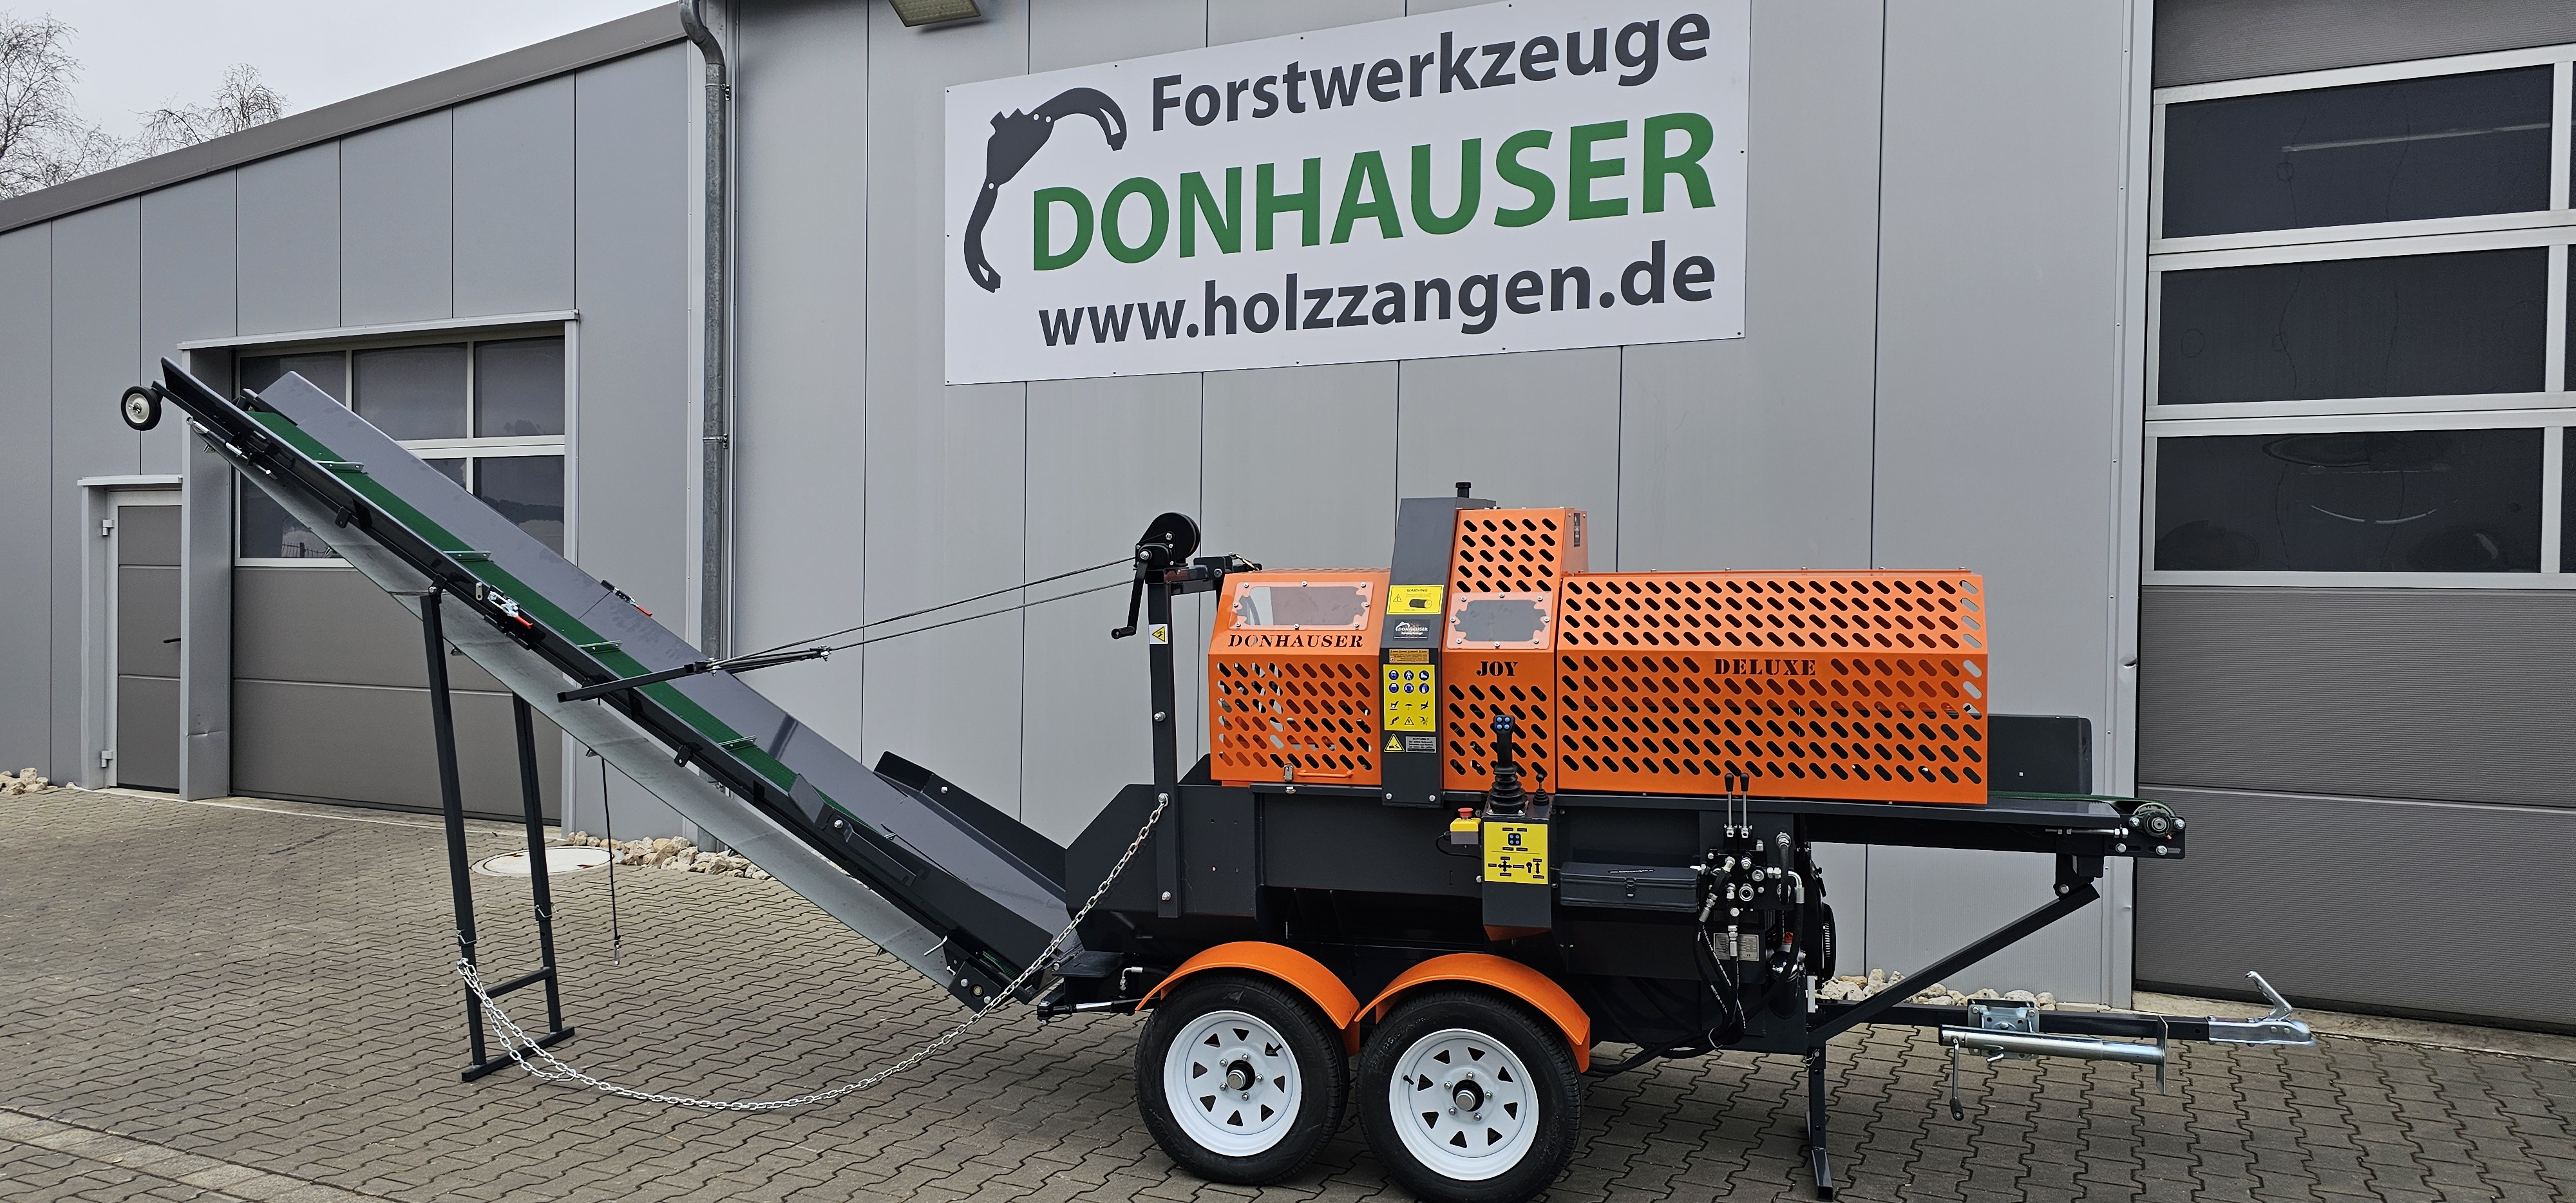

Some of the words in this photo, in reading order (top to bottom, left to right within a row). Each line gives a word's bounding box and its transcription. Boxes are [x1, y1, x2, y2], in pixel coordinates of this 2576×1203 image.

[1153, 13, 1710, 131] Forstwerkzeuge
[1034, 113, 1715, 270] DONHAUSER
[1038, 240, 1716, 346] www.holzzangen.de
[1227, 634, 1363, 648] DONHAUSER
[1476, 661, 1519, 677] JOY
[1714, 659, 1815, 676] DELUXE
